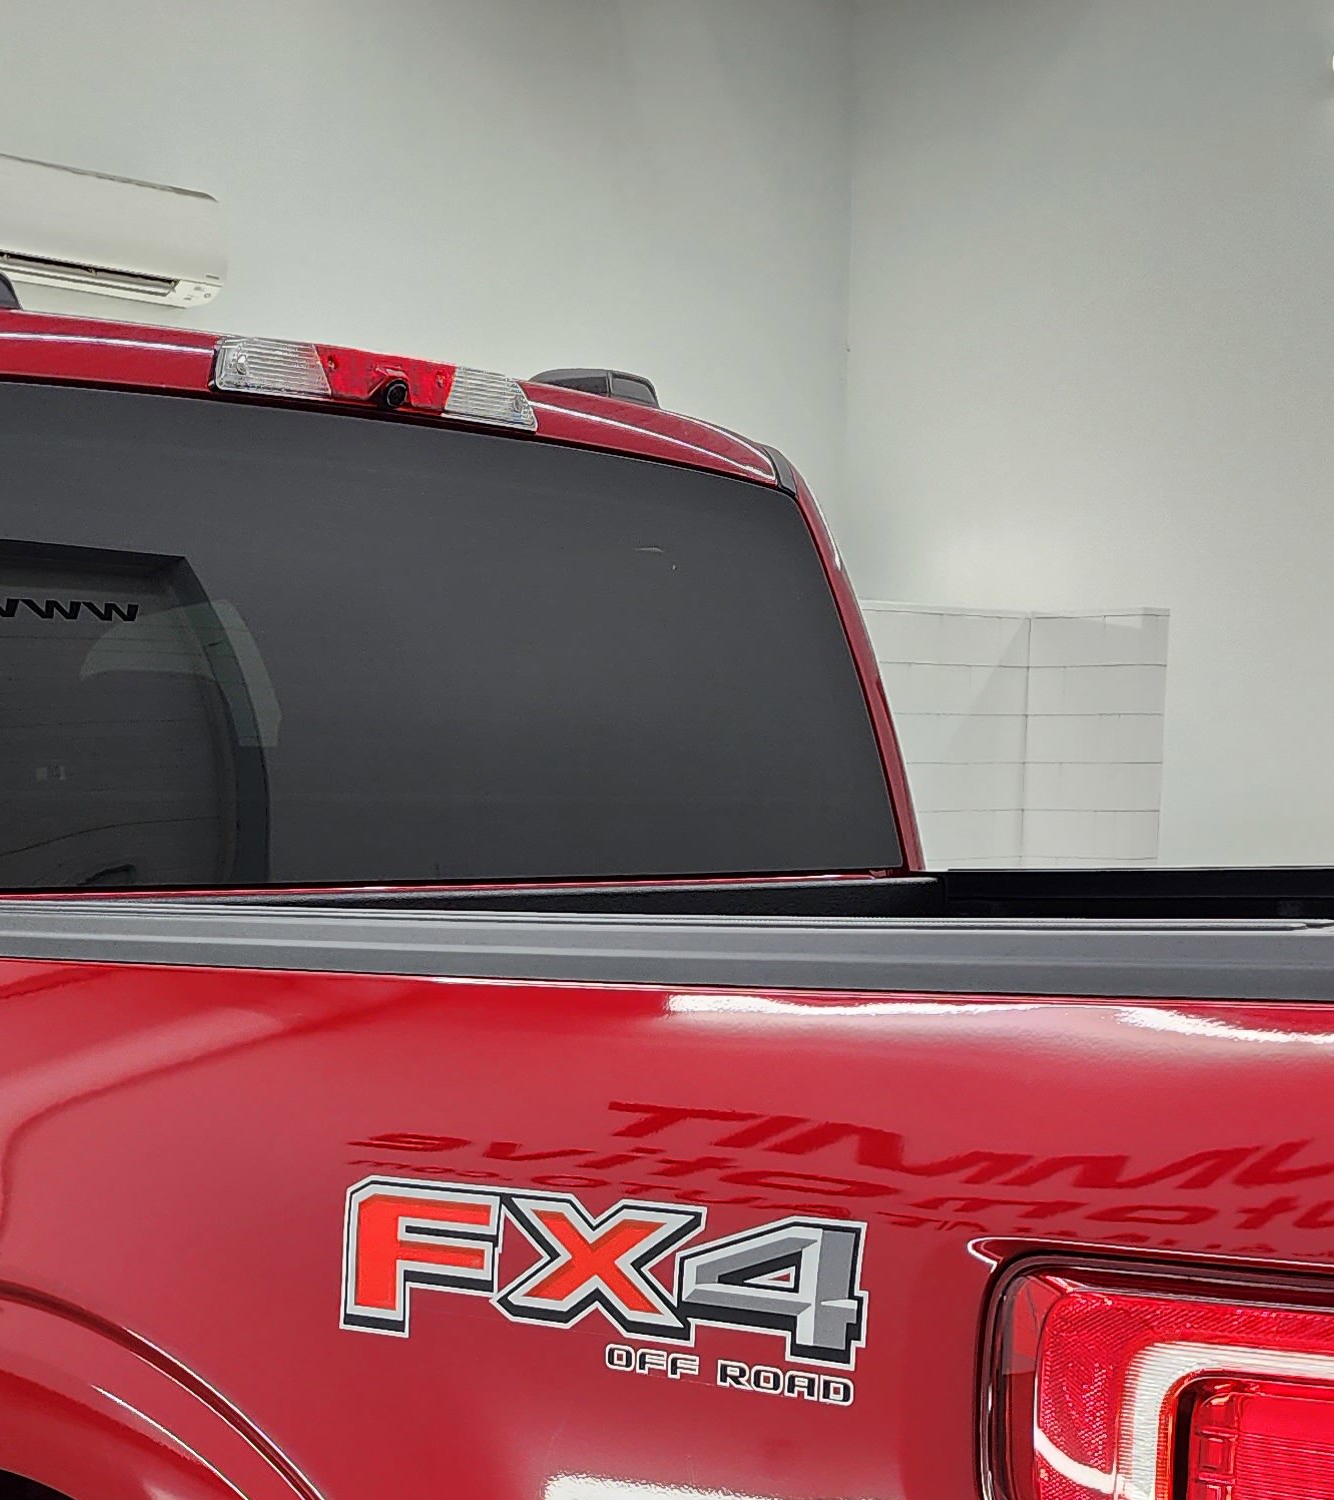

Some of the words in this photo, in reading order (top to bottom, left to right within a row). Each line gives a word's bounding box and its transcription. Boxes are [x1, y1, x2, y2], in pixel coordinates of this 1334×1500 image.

[339, 1174, 869, 1370] FX4
[605, 1343, 700, 1380] OFF
[717, 1360, 855, 1406] ROAD
